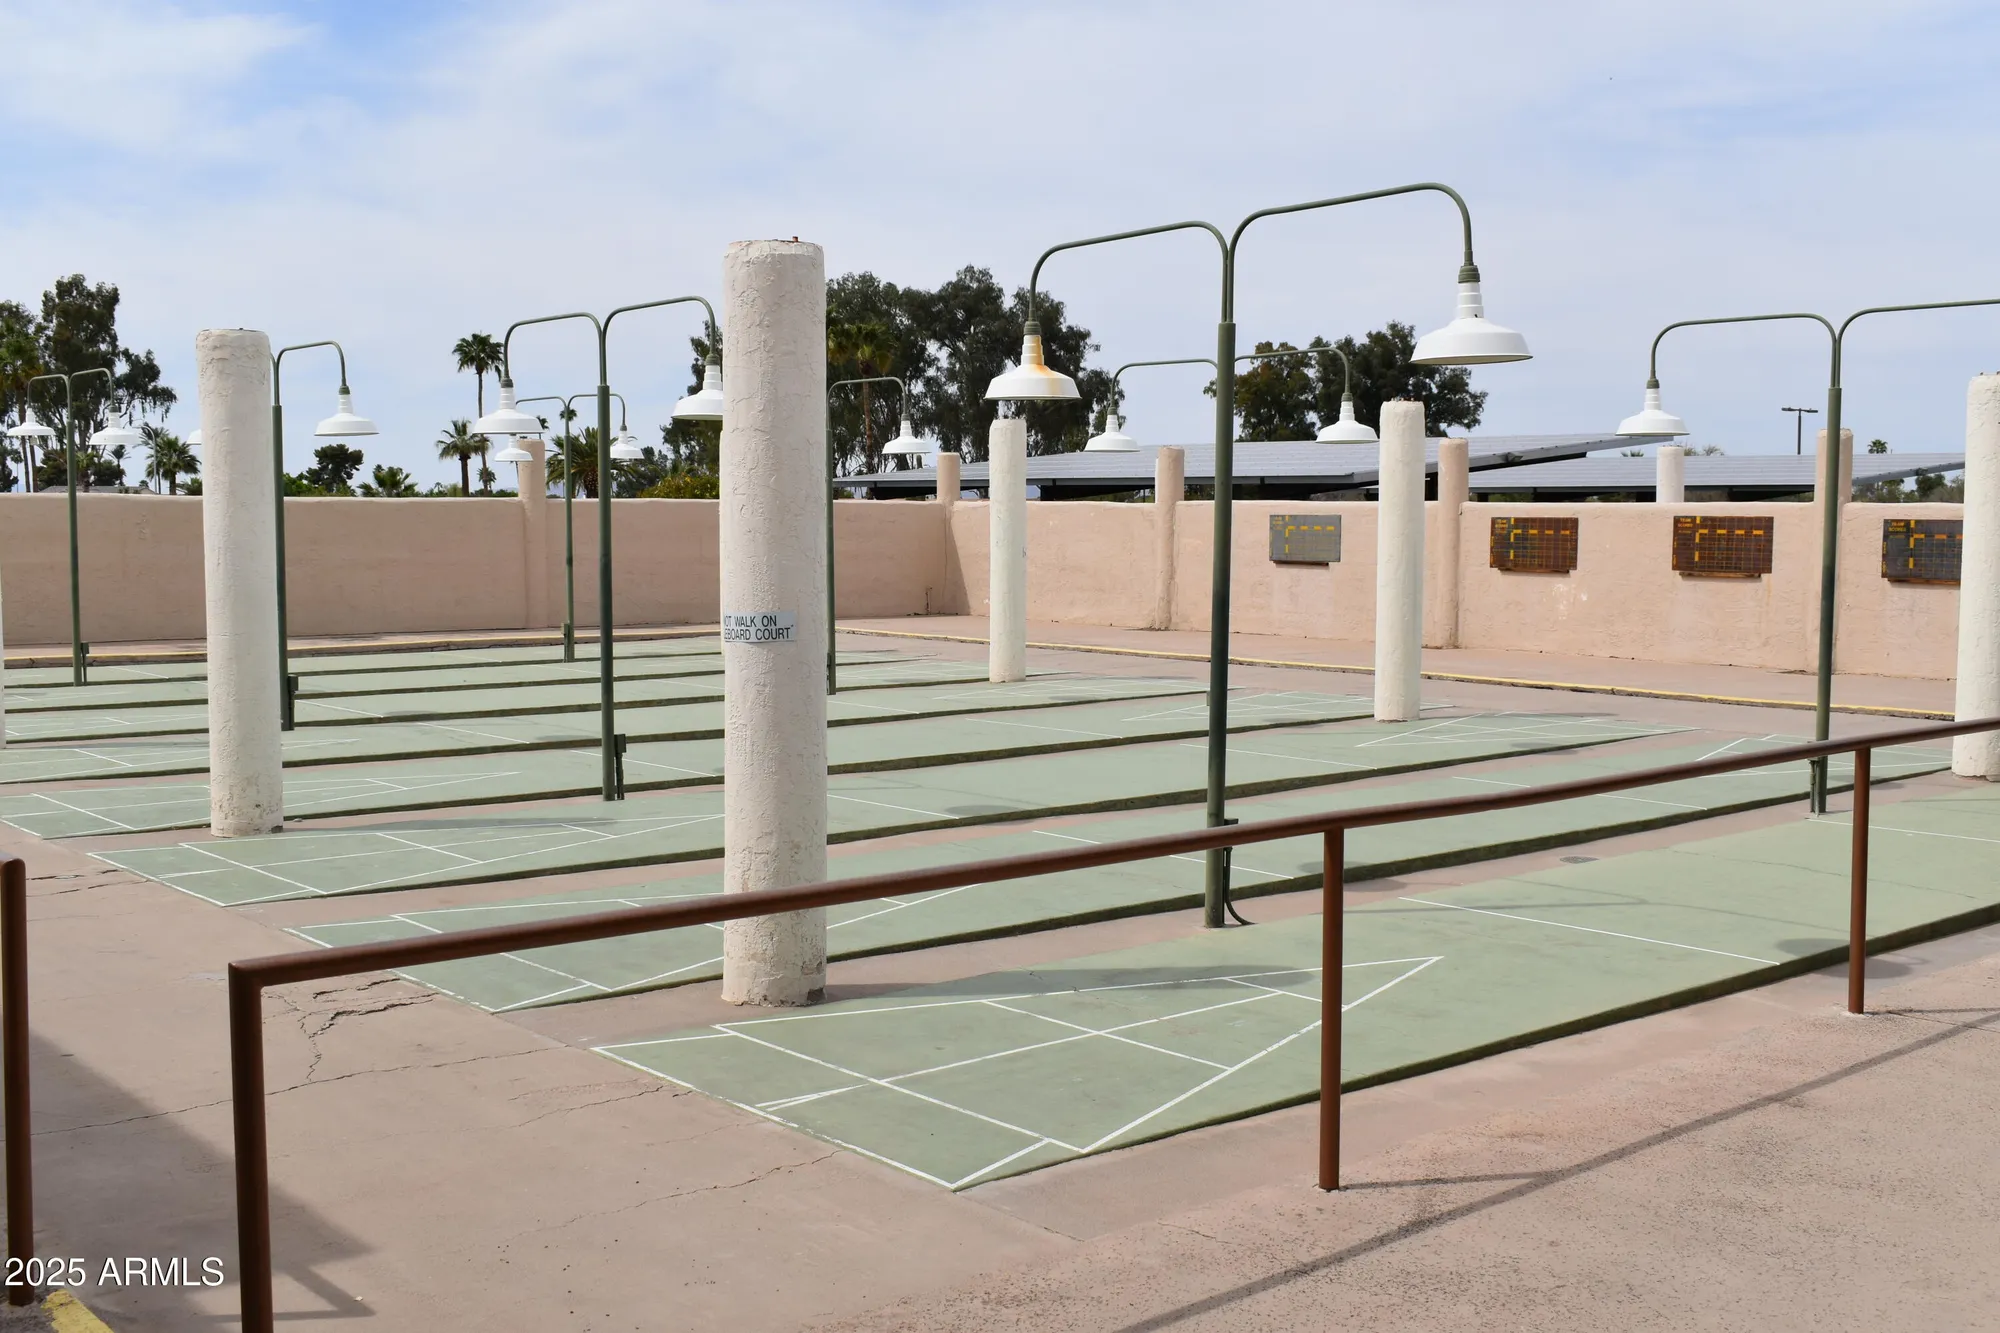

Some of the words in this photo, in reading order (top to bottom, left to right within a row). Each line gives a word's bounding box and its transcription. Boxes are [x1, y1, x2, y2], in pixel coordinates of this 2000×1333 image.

[734, 615, 757, 628] WALK
[761, 615, 777, 628] ON
[755, 627, 791, 641] COURT
